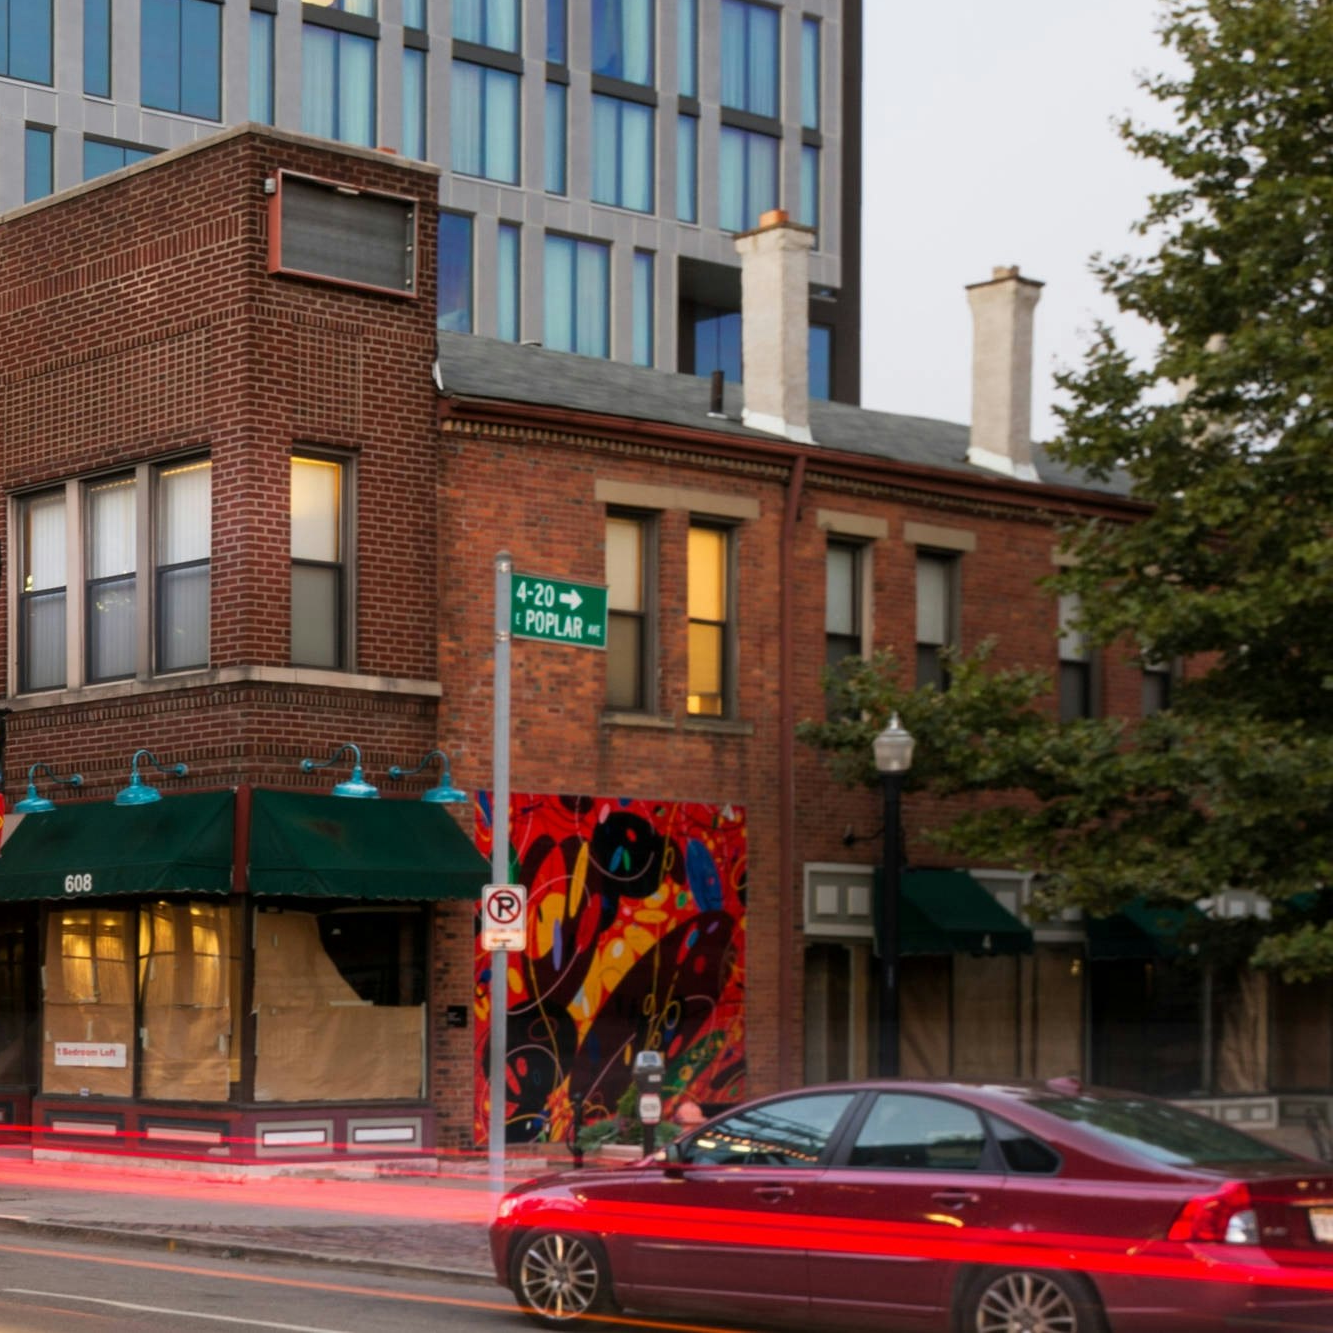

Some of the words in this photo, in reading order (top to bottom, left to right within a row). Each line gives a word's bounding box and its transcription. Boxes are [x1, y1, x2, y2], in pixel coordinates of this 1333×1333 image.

[516, 581, 555, 608] 4-20
[515, 612, 521, 625] E
[525, 609, 583, 639] POPLAR
[64, 874, 93, 893] 608
